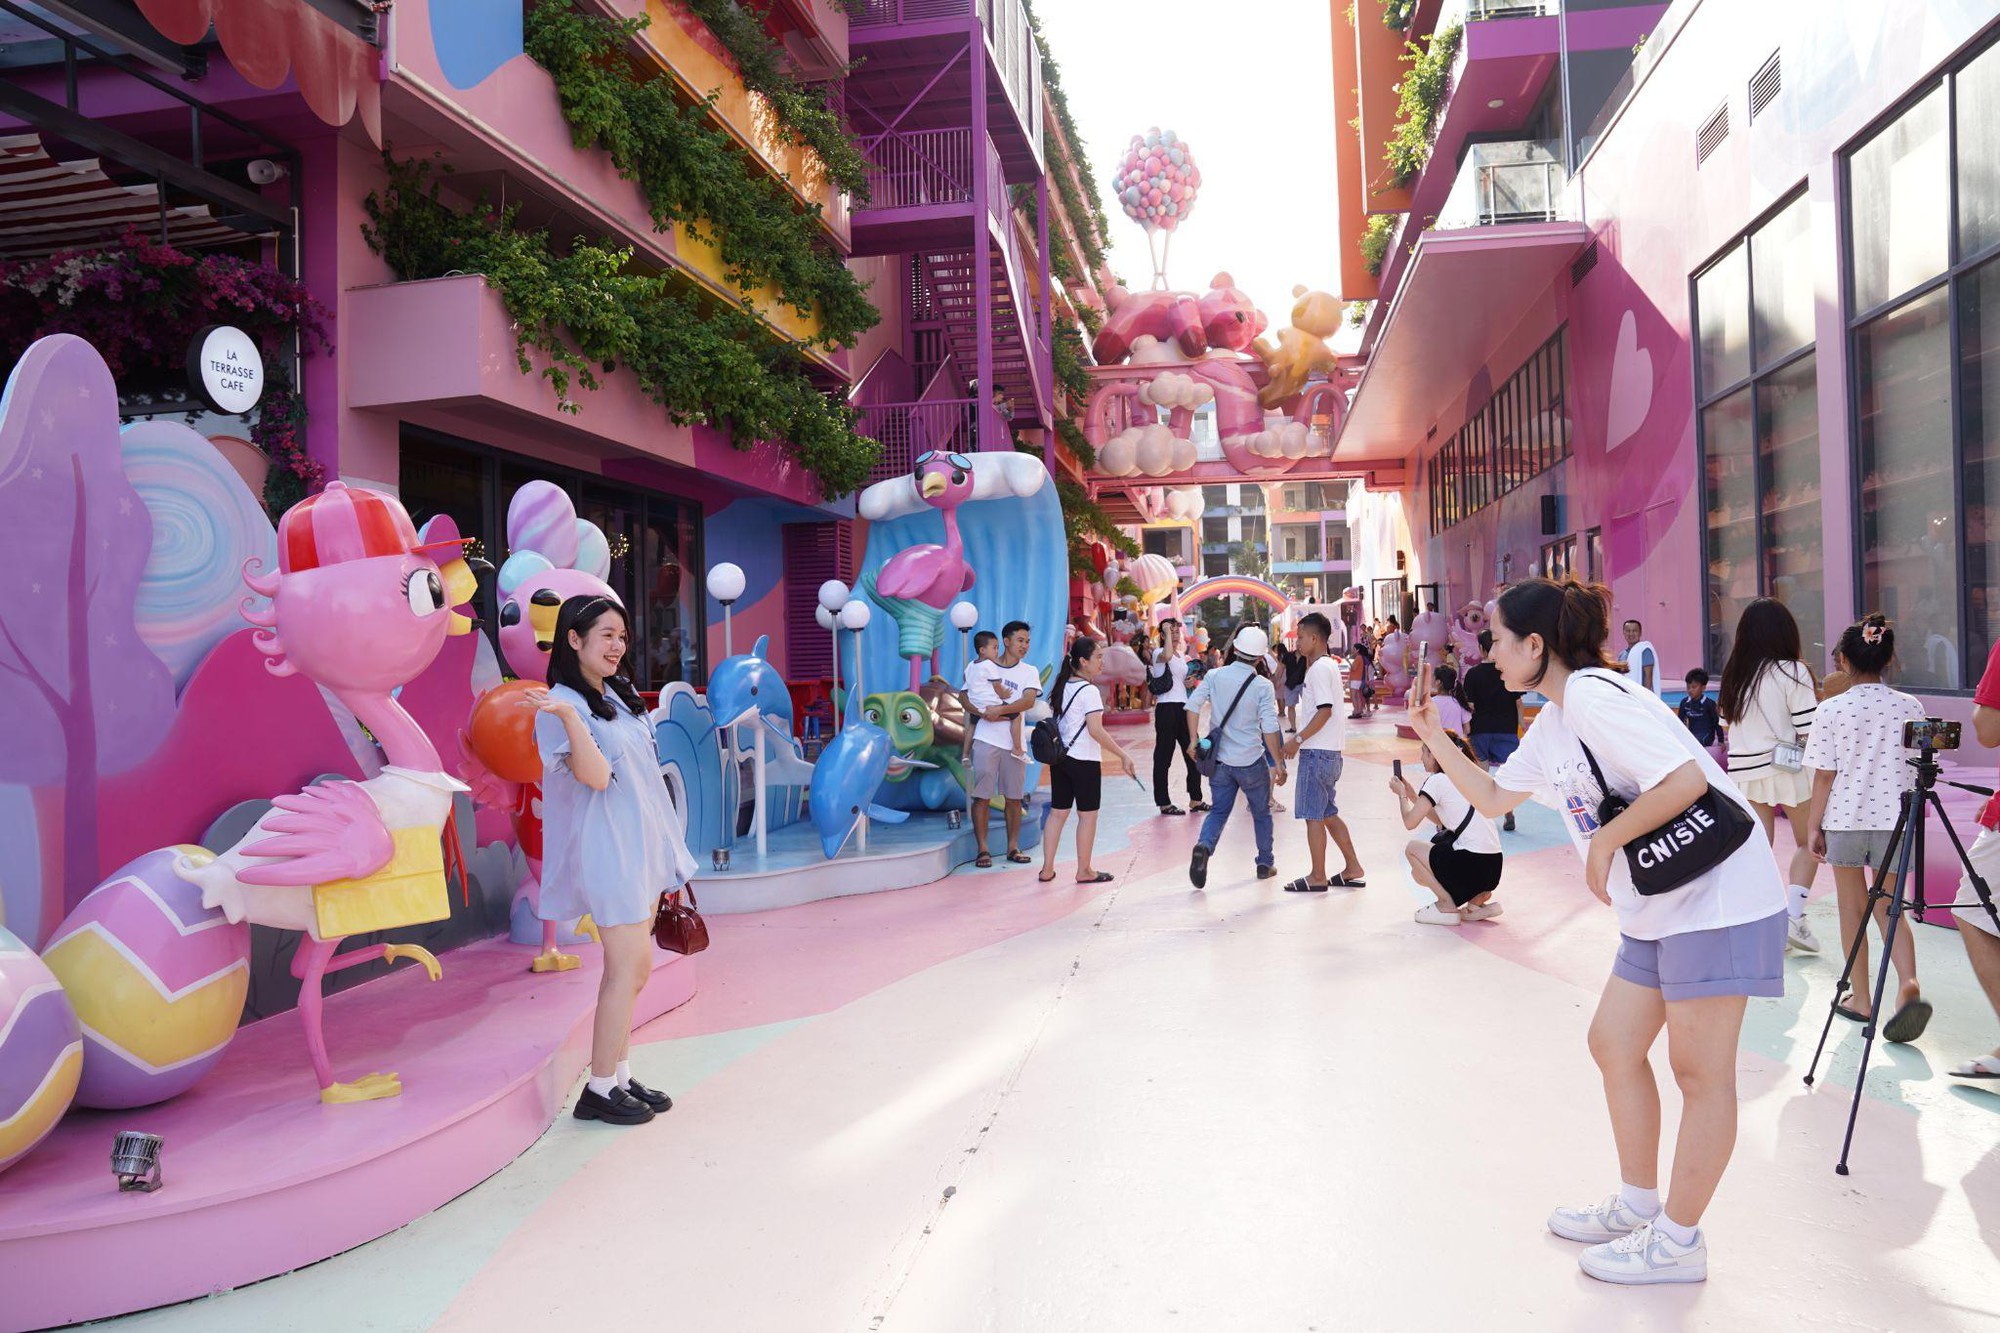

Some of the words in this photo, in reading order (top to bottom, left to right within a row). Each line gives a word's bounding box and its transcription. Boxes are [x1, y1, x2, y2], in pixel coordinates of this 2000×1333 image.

[226, 349, 238, 361] LA
[210, 360, 254, 380] TERRASSE
[220, 378, 245, 393] CAFE
[1637, 808, 1716, 869] CNISIE
